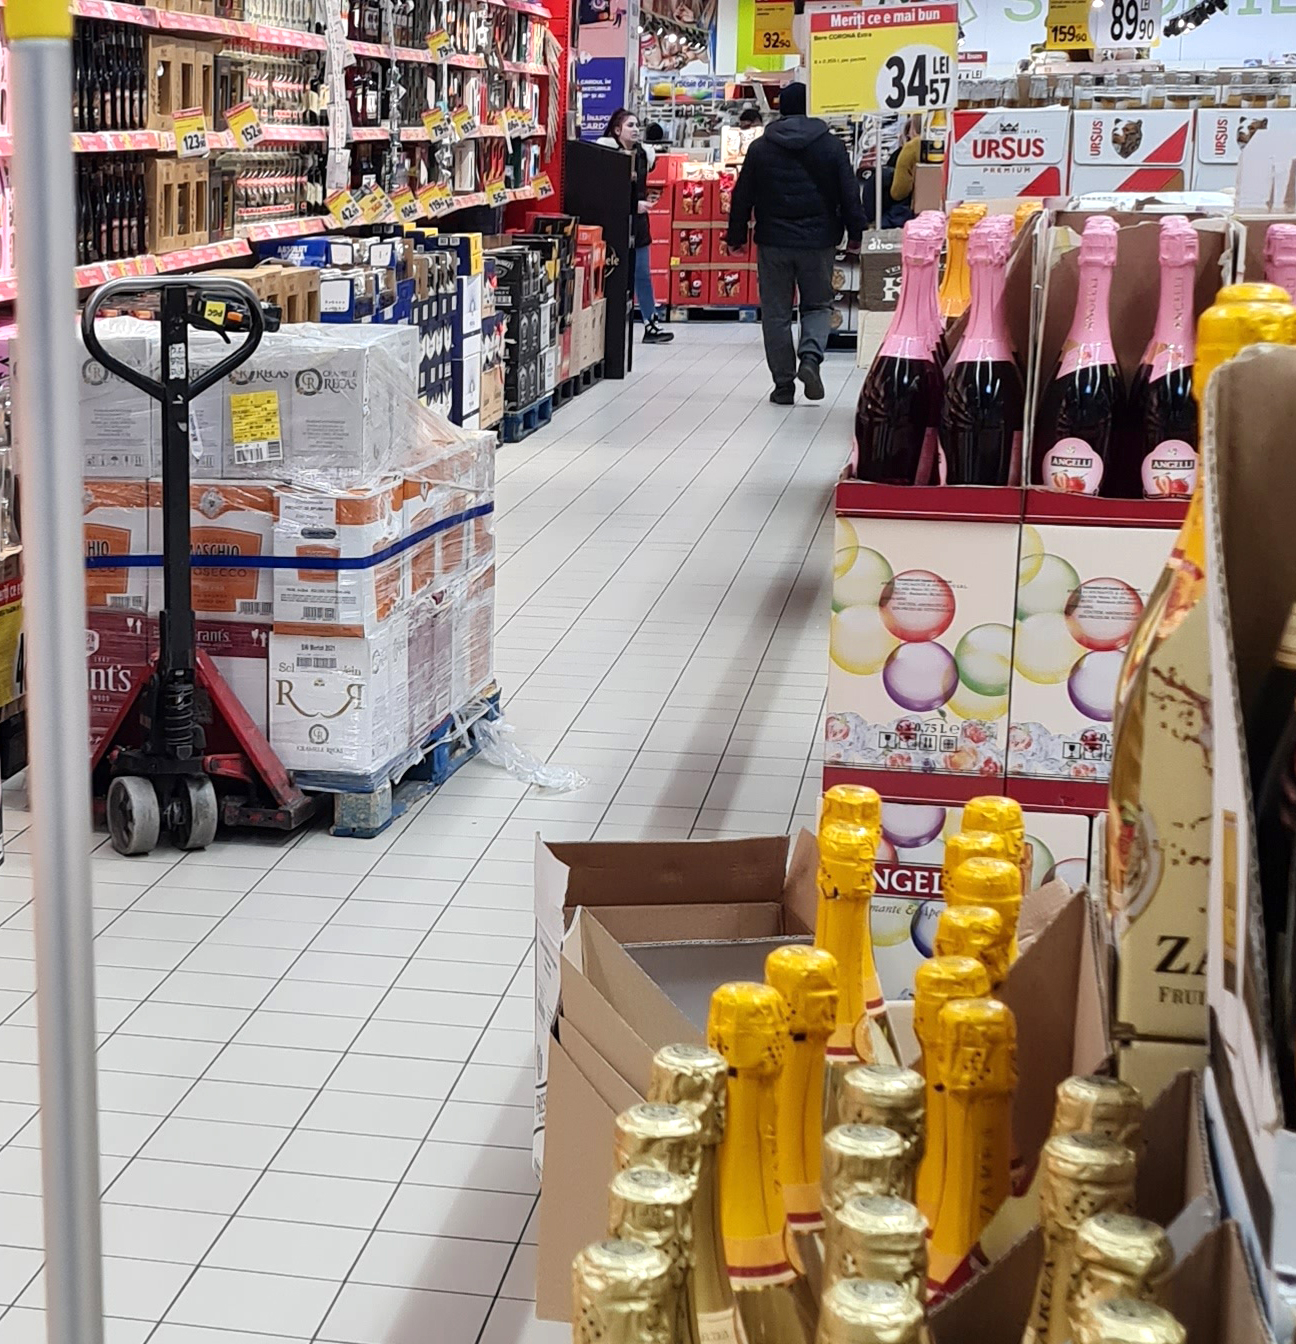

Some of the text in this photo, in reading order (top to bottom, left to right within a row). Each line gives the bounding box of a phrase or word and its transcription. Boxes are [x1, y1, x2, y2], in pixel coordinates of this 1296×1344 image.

[831, 13, 864, 30] Meriți
[868, 14, 881, 25] ce
[893, 11, 915, 23] mai
[918, 8, 940, 21] bun
[1109, 0, 1138, 41] 89
[1052, 25, 1075, 43] 159
[1139, 19, 1155, 40] 90
[764, 32, 780, 48] 32
[933, 55, 949, 75] LEI
[885, 54, 929, 109] 34
[929, 79, 951, 105] 57
[183, 134, 200, 151] 123
[241, 125, 258, 142] 152
[1089, 120, 1103, 157] URSUS
[1214, 118, 1228, 156] URSUS
[972, 137, 1044, 160] URSUS
[342, 206, 353, 222] 42
[1052, 456, 1092, 467] ANGELLI
[1152, 460, 1194, 470] ANGELLI
